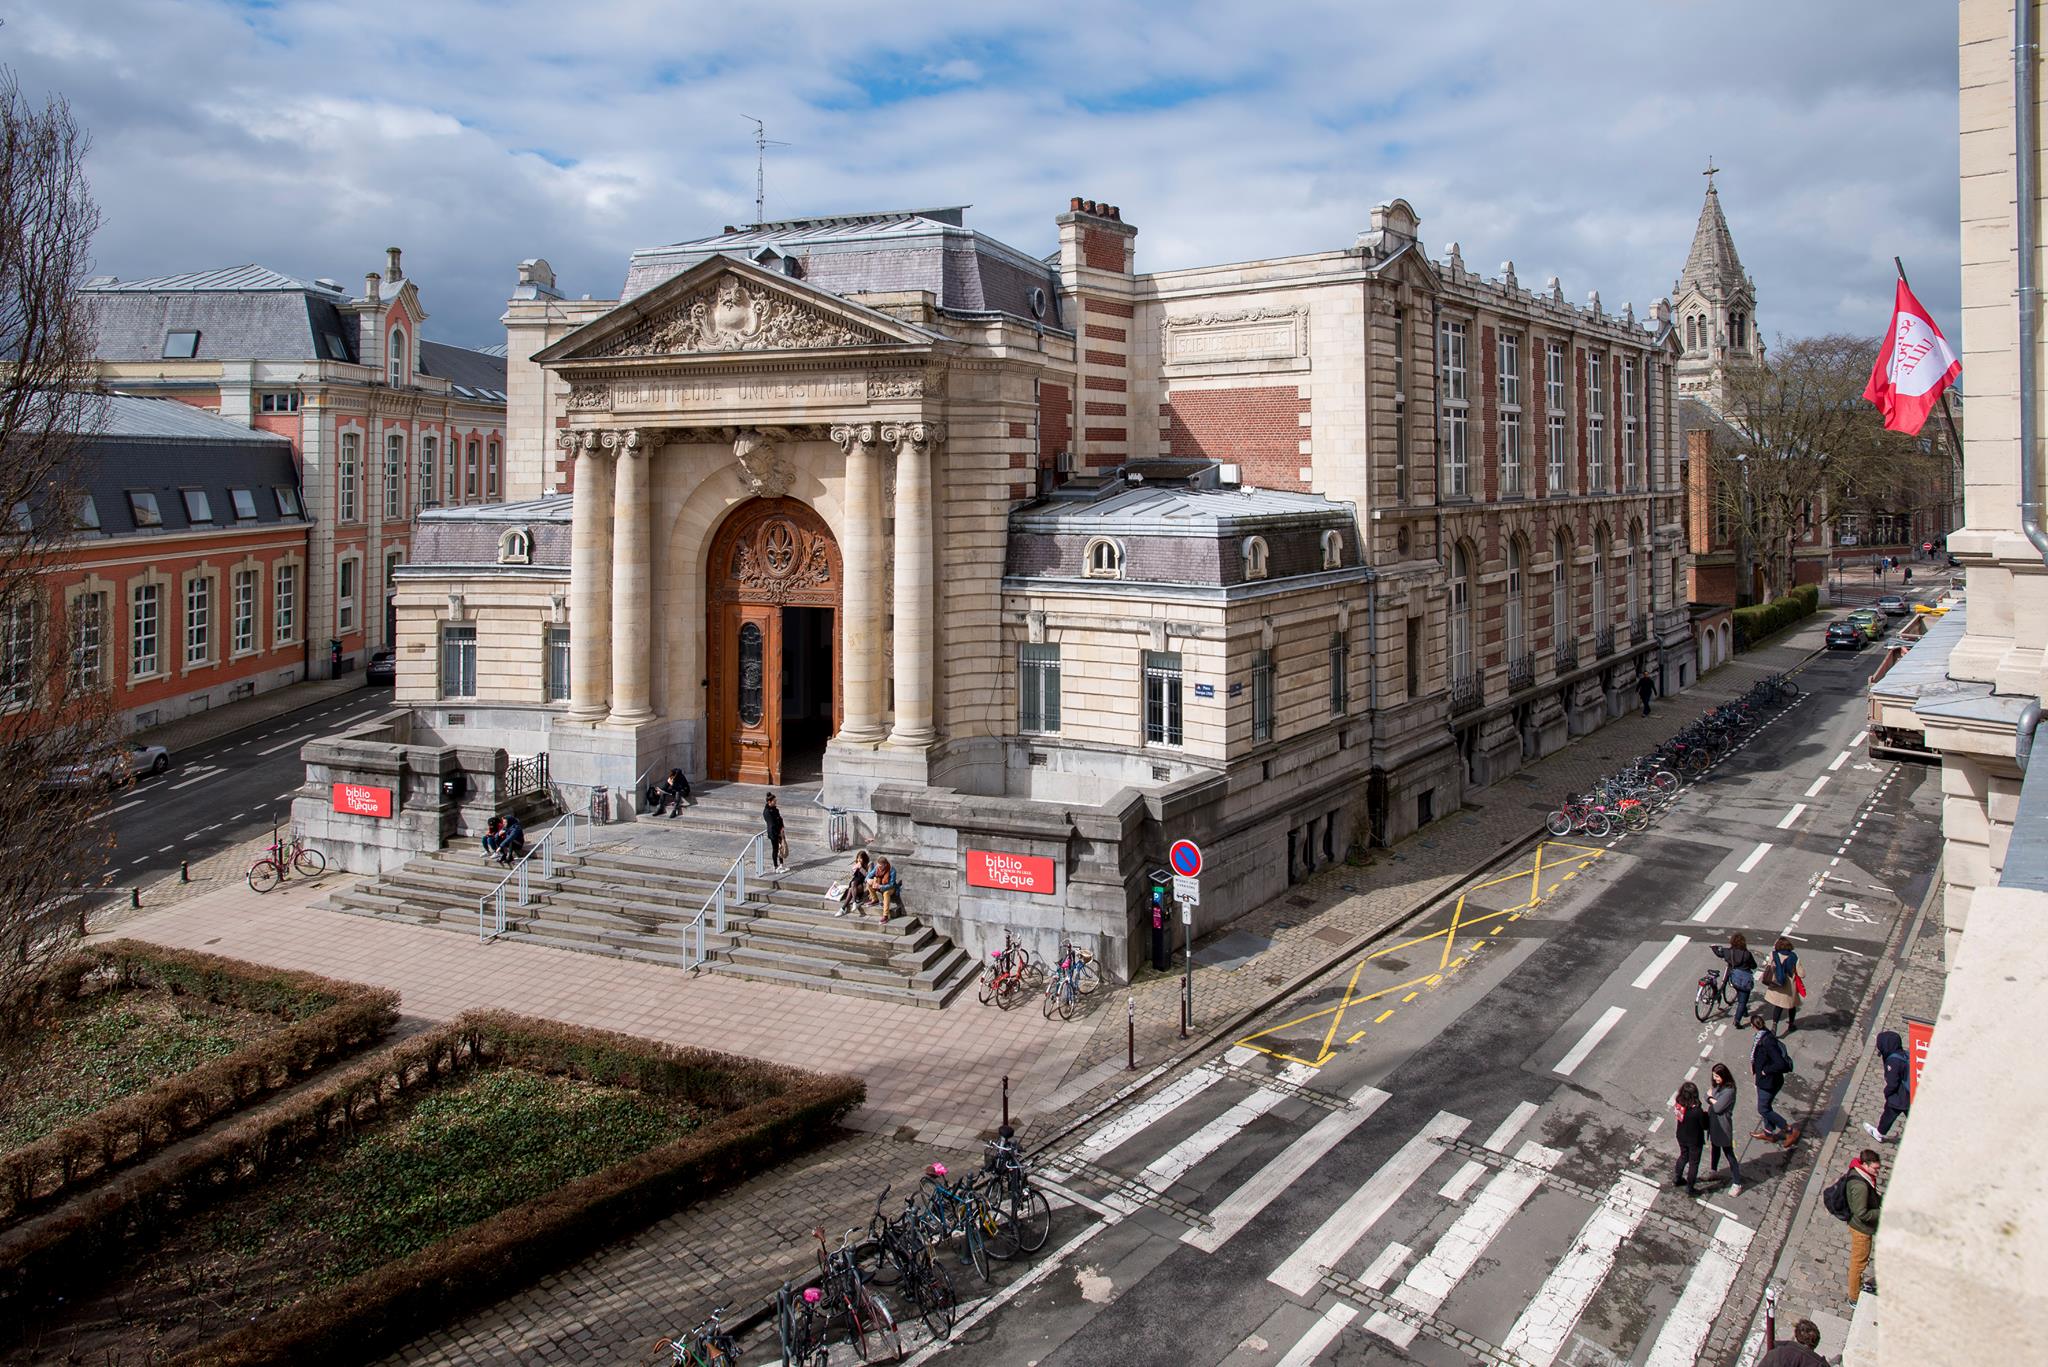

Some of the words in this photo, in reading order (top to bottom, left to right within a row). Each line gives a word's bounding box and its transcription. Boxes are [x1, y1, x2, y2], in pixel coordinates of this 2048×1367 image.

[617, 382, 722, 404] BIBLIOTHEQUE
[738, 376, 861, 400] UNIVERSITAIRE
[345, 786, 371, 799] biblio
[985, 854, 1022, 870] biblio
[988, 866, 1034, 888] thèque
